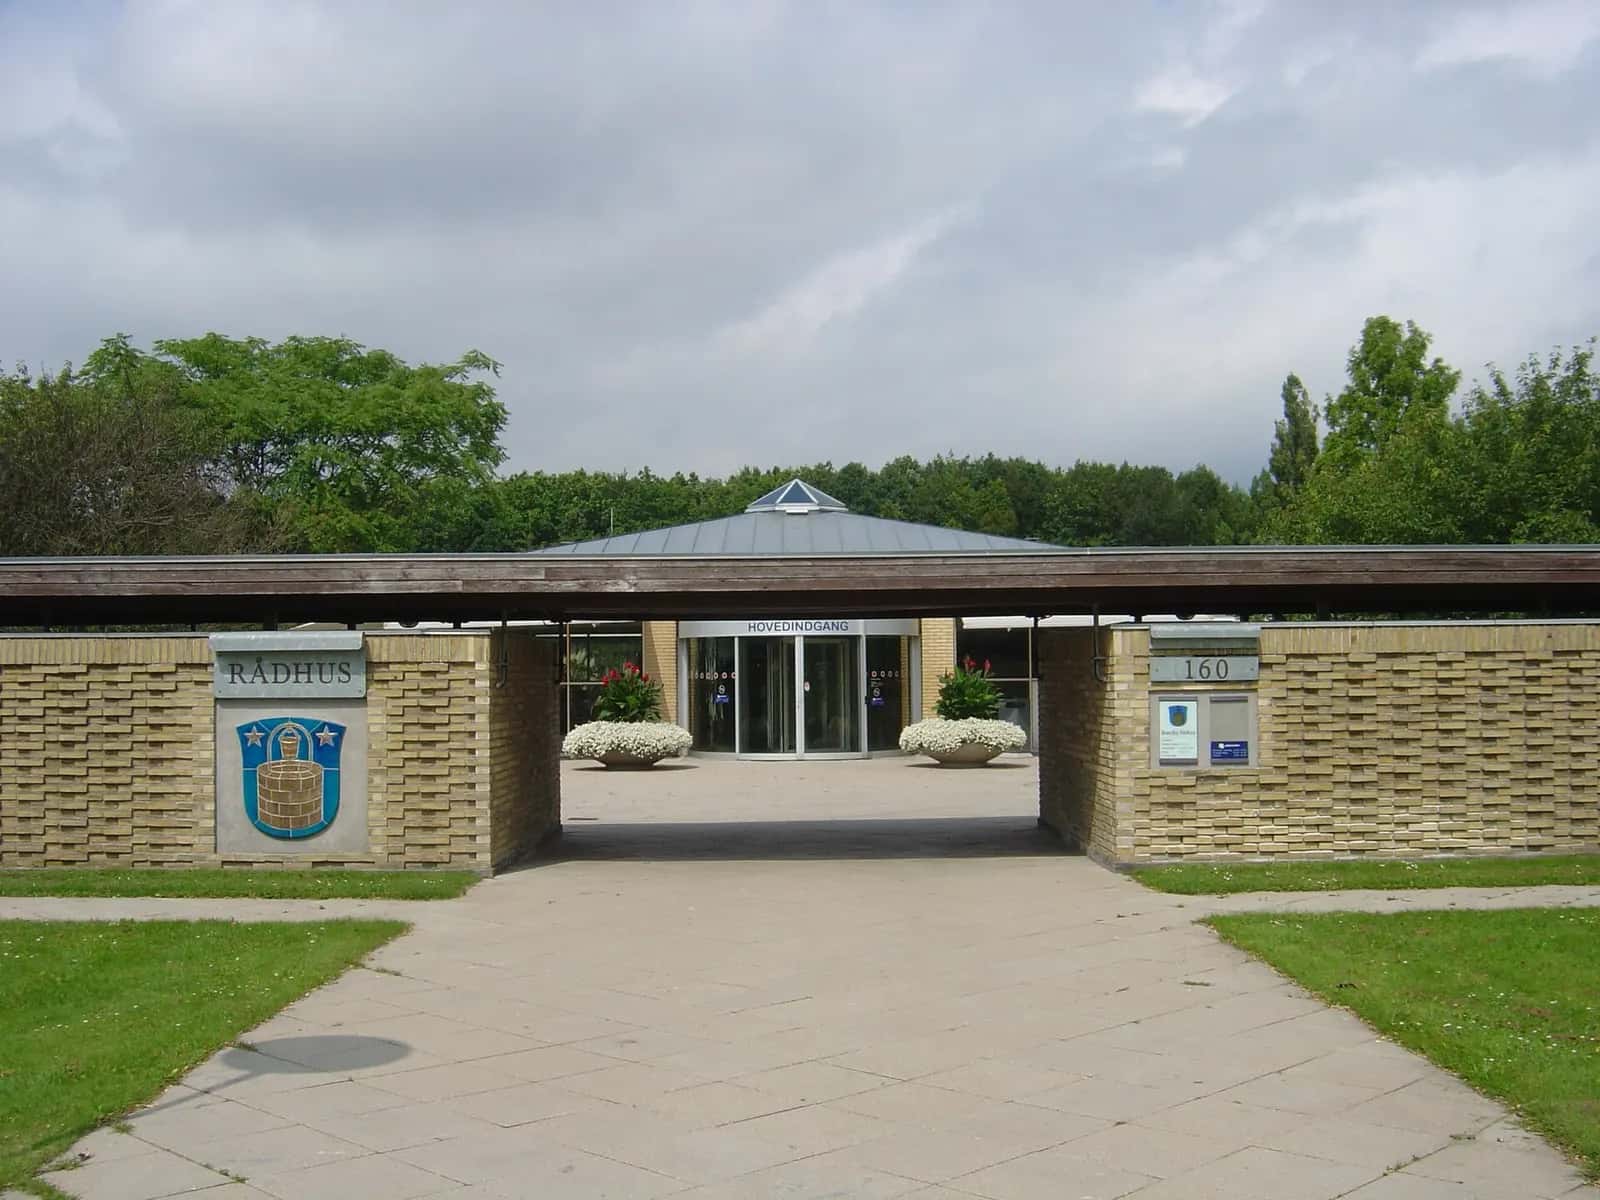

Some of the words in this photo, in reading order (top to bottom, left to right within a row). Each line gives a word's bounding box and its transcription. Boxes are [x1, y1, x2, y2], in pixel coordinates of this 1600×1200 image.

[748, 621, 849, 632] HOVEDINDGANG
[228, 656, 352, 684] RÅDHUS
[1185, 659, 1229, 680] 160
